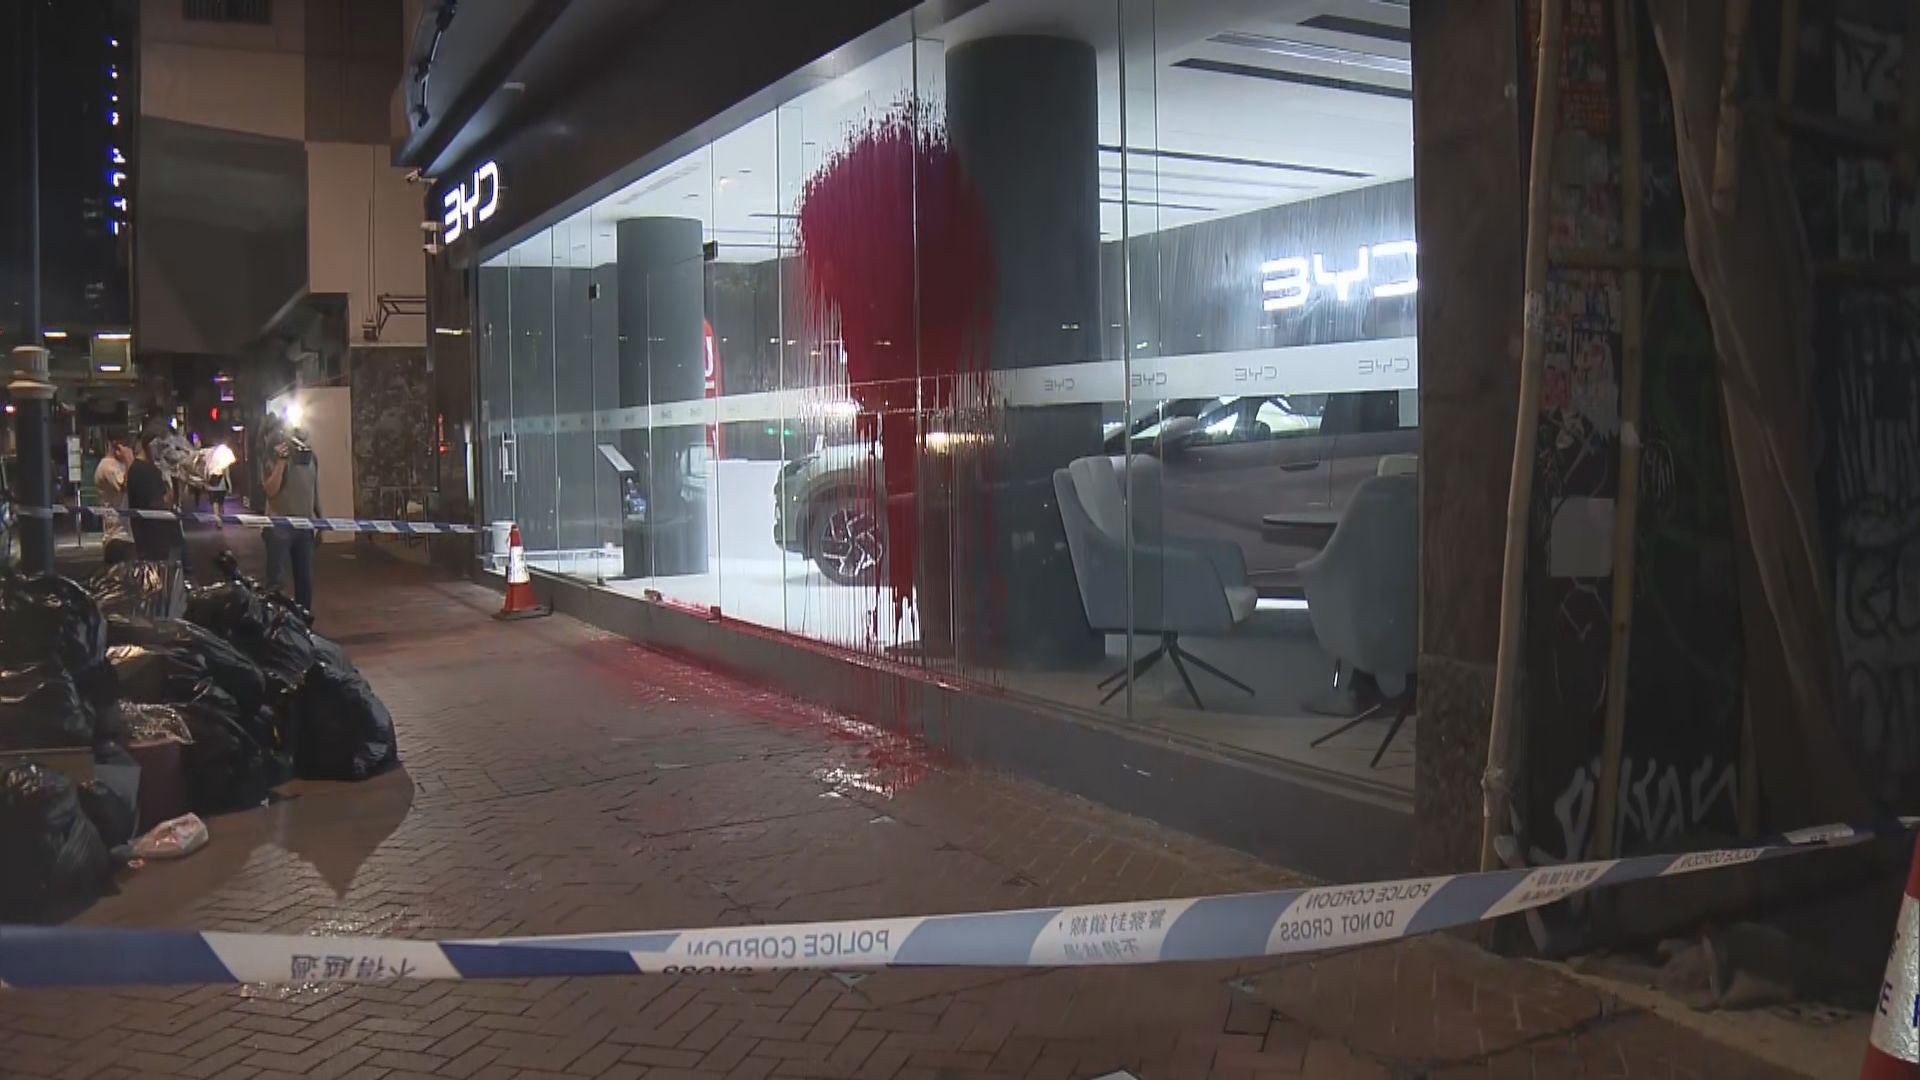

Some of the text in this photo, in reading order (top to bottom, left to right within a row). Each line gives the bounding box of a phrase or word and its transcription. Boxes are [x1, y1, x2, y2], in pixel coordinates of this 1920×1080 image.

[443, 160, 499, 245] BYD
[1261, 239, 1418, 311] BYD
[1234, 365, 1278, 382] BYD
[1357, 357, 1410, 375] BYD
[1043, 377, 1076, 391] BYD
[1131, 371, 1168, 388] BYD
